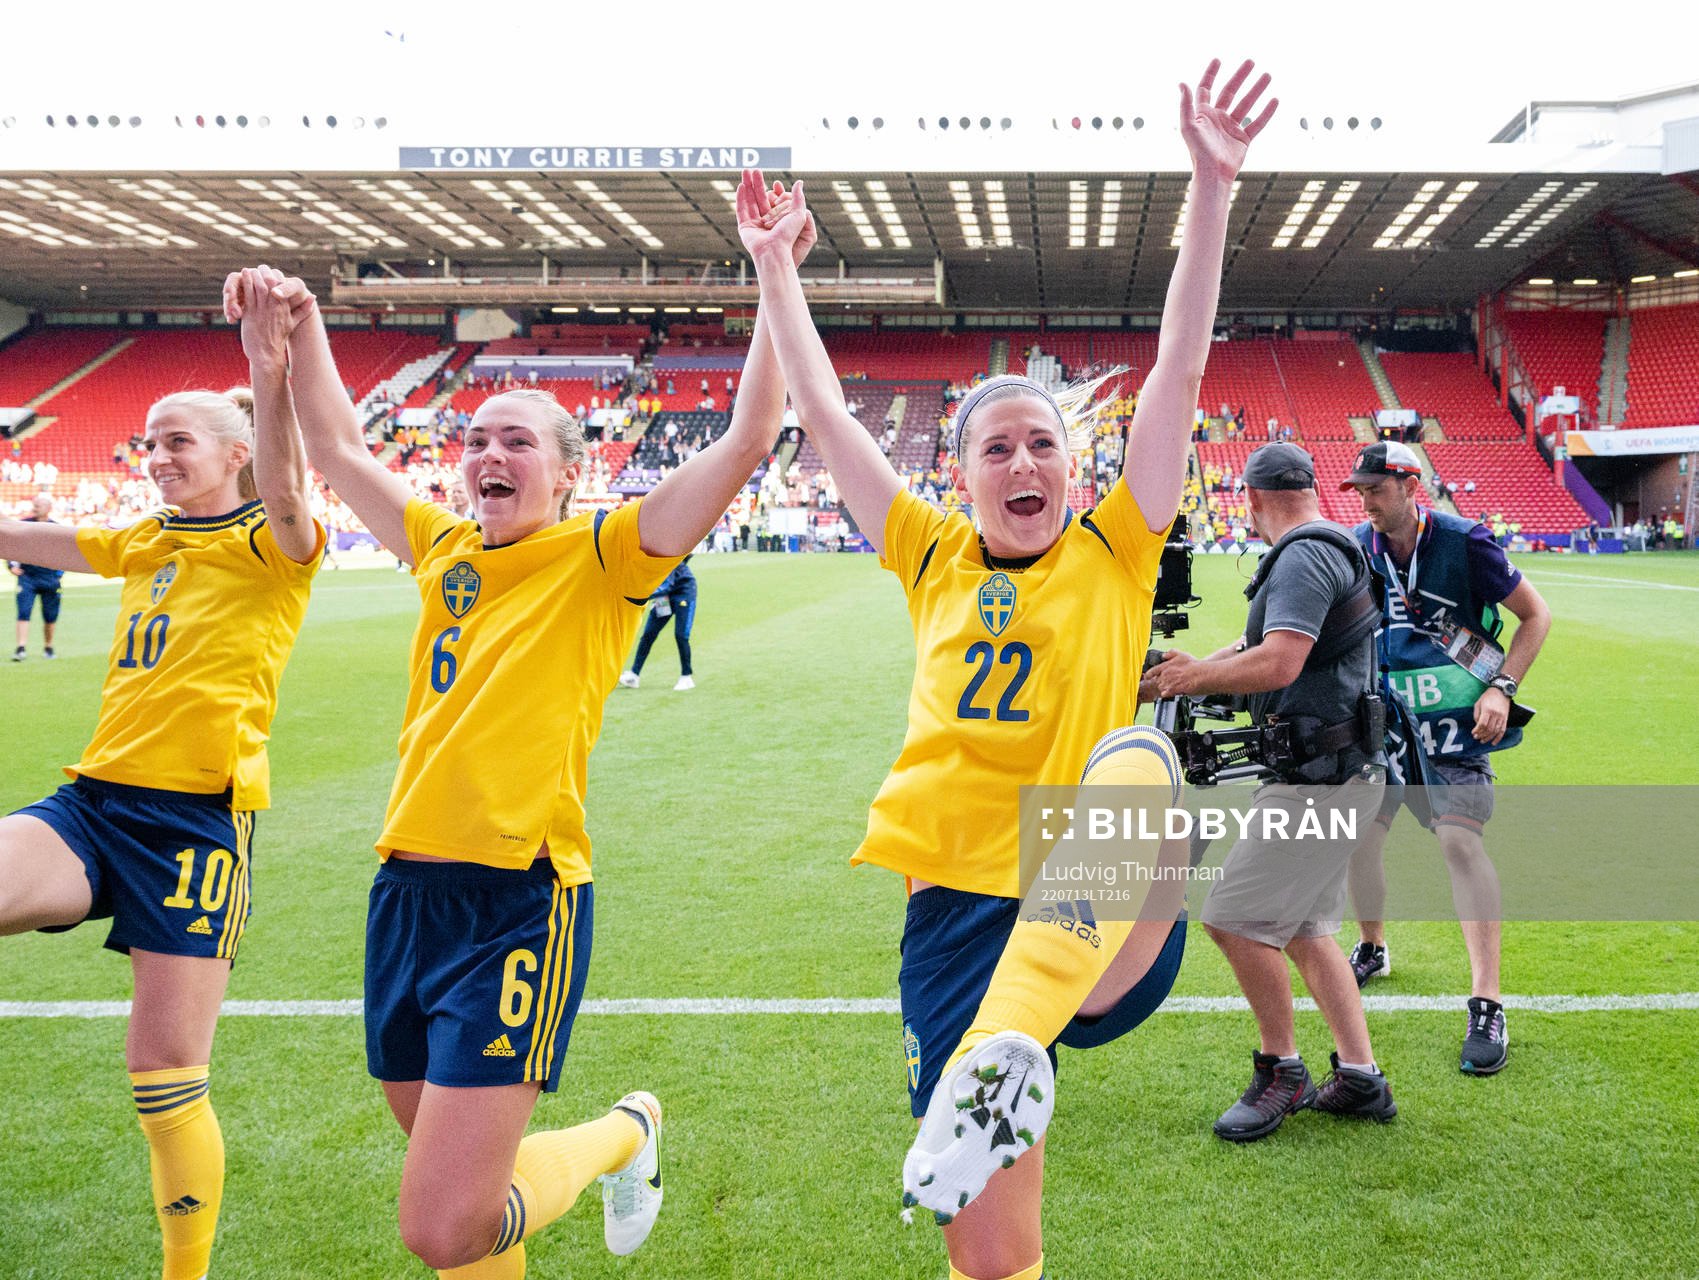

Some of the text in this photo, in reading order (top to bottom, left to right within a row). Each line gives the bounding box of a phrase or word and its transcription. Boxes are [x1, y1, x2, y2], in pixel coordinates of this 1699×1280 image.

[430, 148, 760, 167] TONY CURRIE STAND
[118, 611, 170, 669] 10
[431, 626, 461, 694] 6
[957, 641, 1032, 721] 22
[163, 848, 233, 912] 10
[1026, 912, 1102, 949] adidas
[499, 949, 537, 1027] 6
[482, 1047, 516, 1057] adidas
